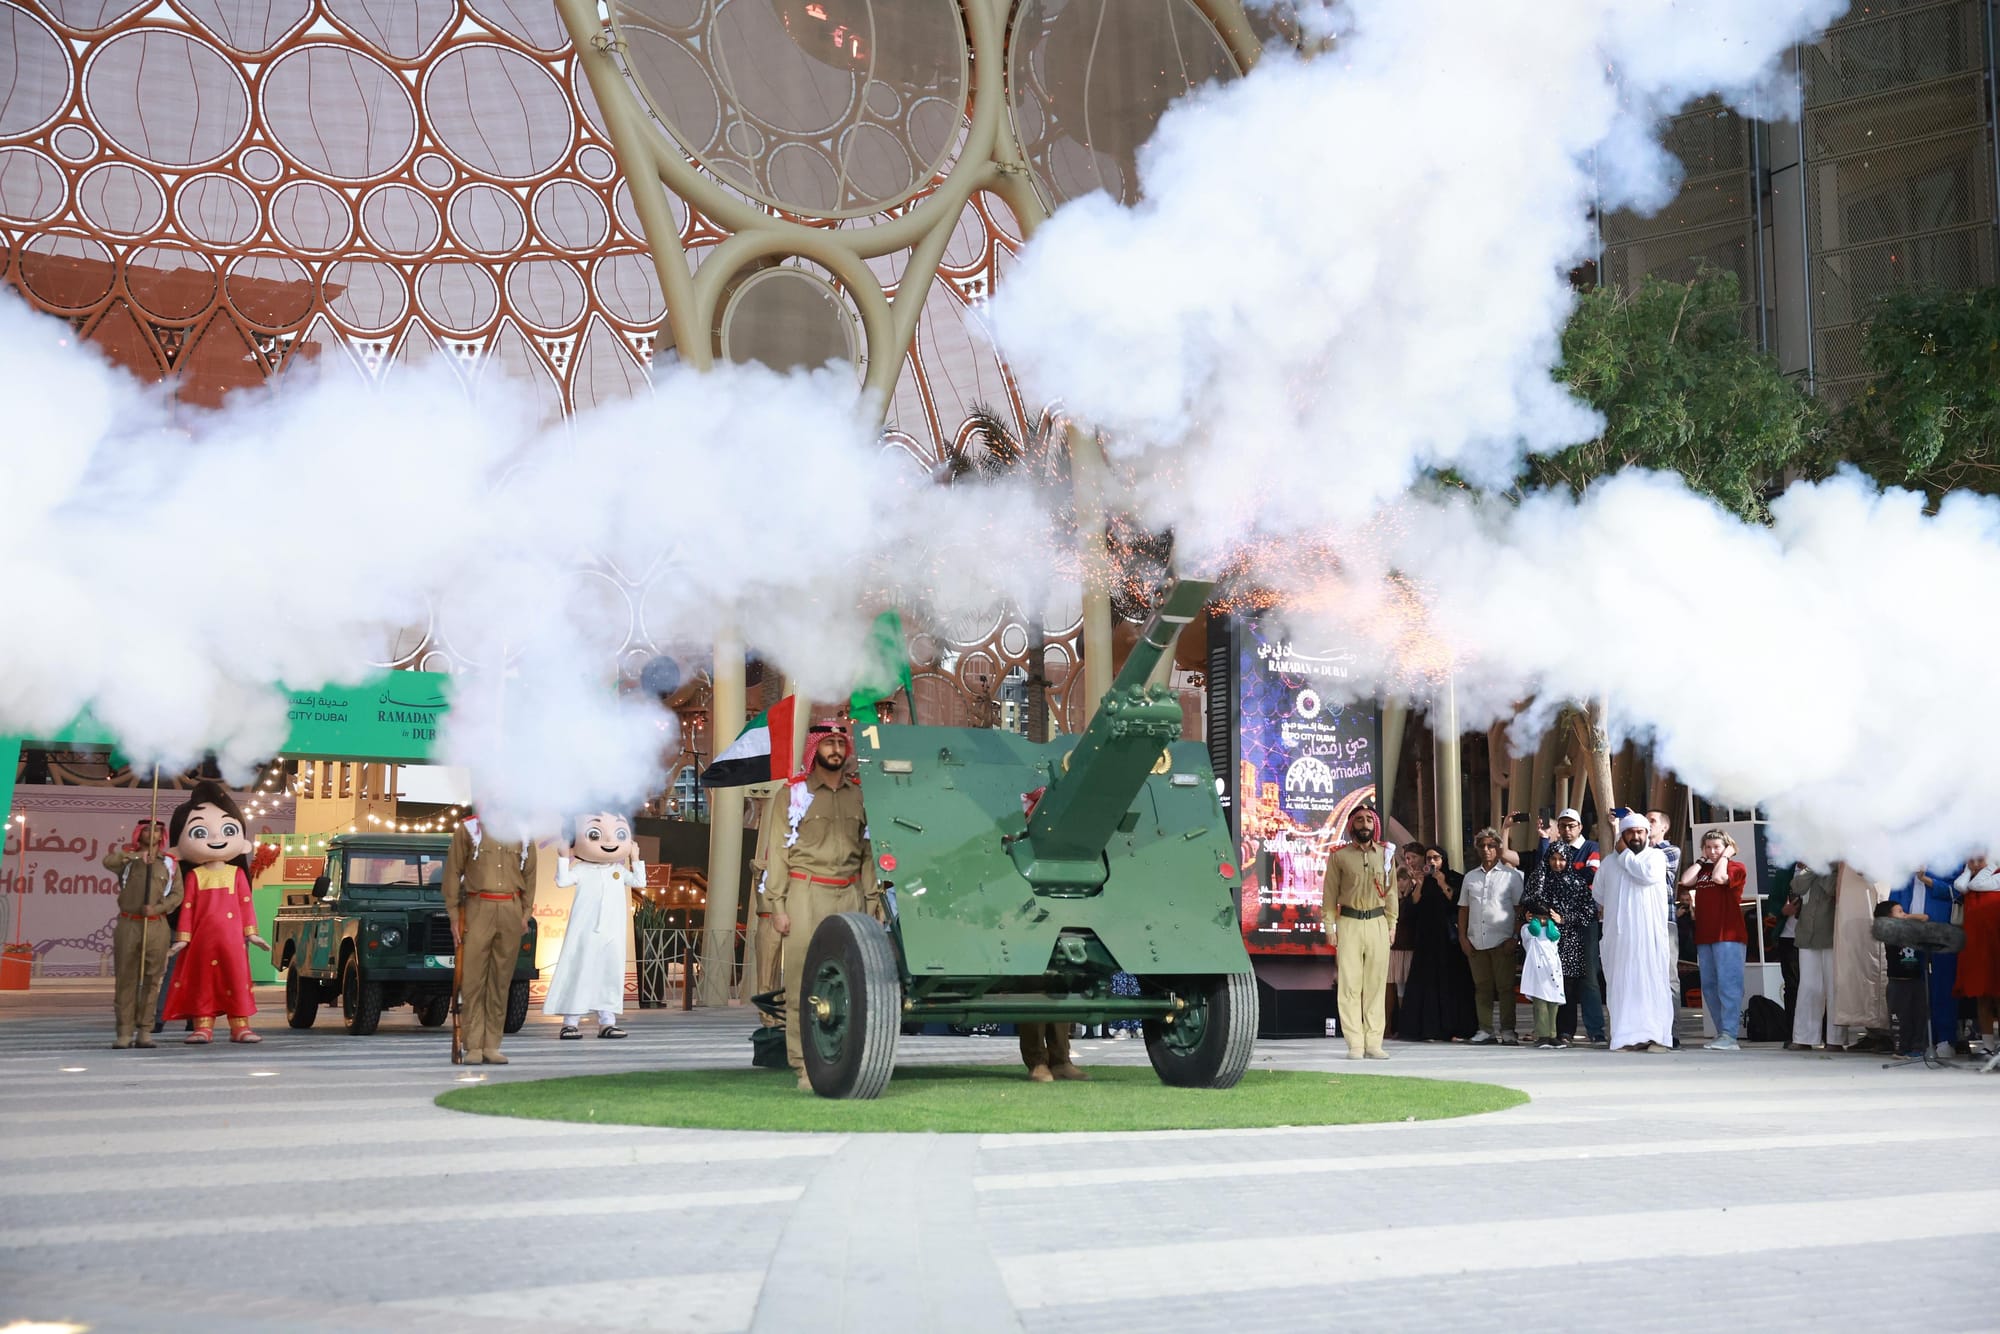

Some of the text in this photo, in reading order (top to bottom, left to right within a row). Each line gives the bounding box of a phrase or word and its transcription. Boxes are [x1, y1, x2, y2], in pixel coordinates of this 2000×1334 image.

[1268, 660, 1312, 674] RAMADAN
[1321, 666, 1347, 677] DUBAI
[318, 697, 348, 708] مدينة
[288, 711, 348, 722] CITY DUBAI
[378, 711, 436, 724] RAMADAN
[412, 729, 436, 740] DUB
[862, 726, 880, 748] 1
[1301, 733, 1315, 741] CITY
[1315, 734, 1336, 742] DUBAI
[1311, 803, 1334, 811] SEASON
[3, 827, 98, 861] رمضان
[1263, 839, 1301, 854] SEASON
[1258, 896, 1271, 904] One
